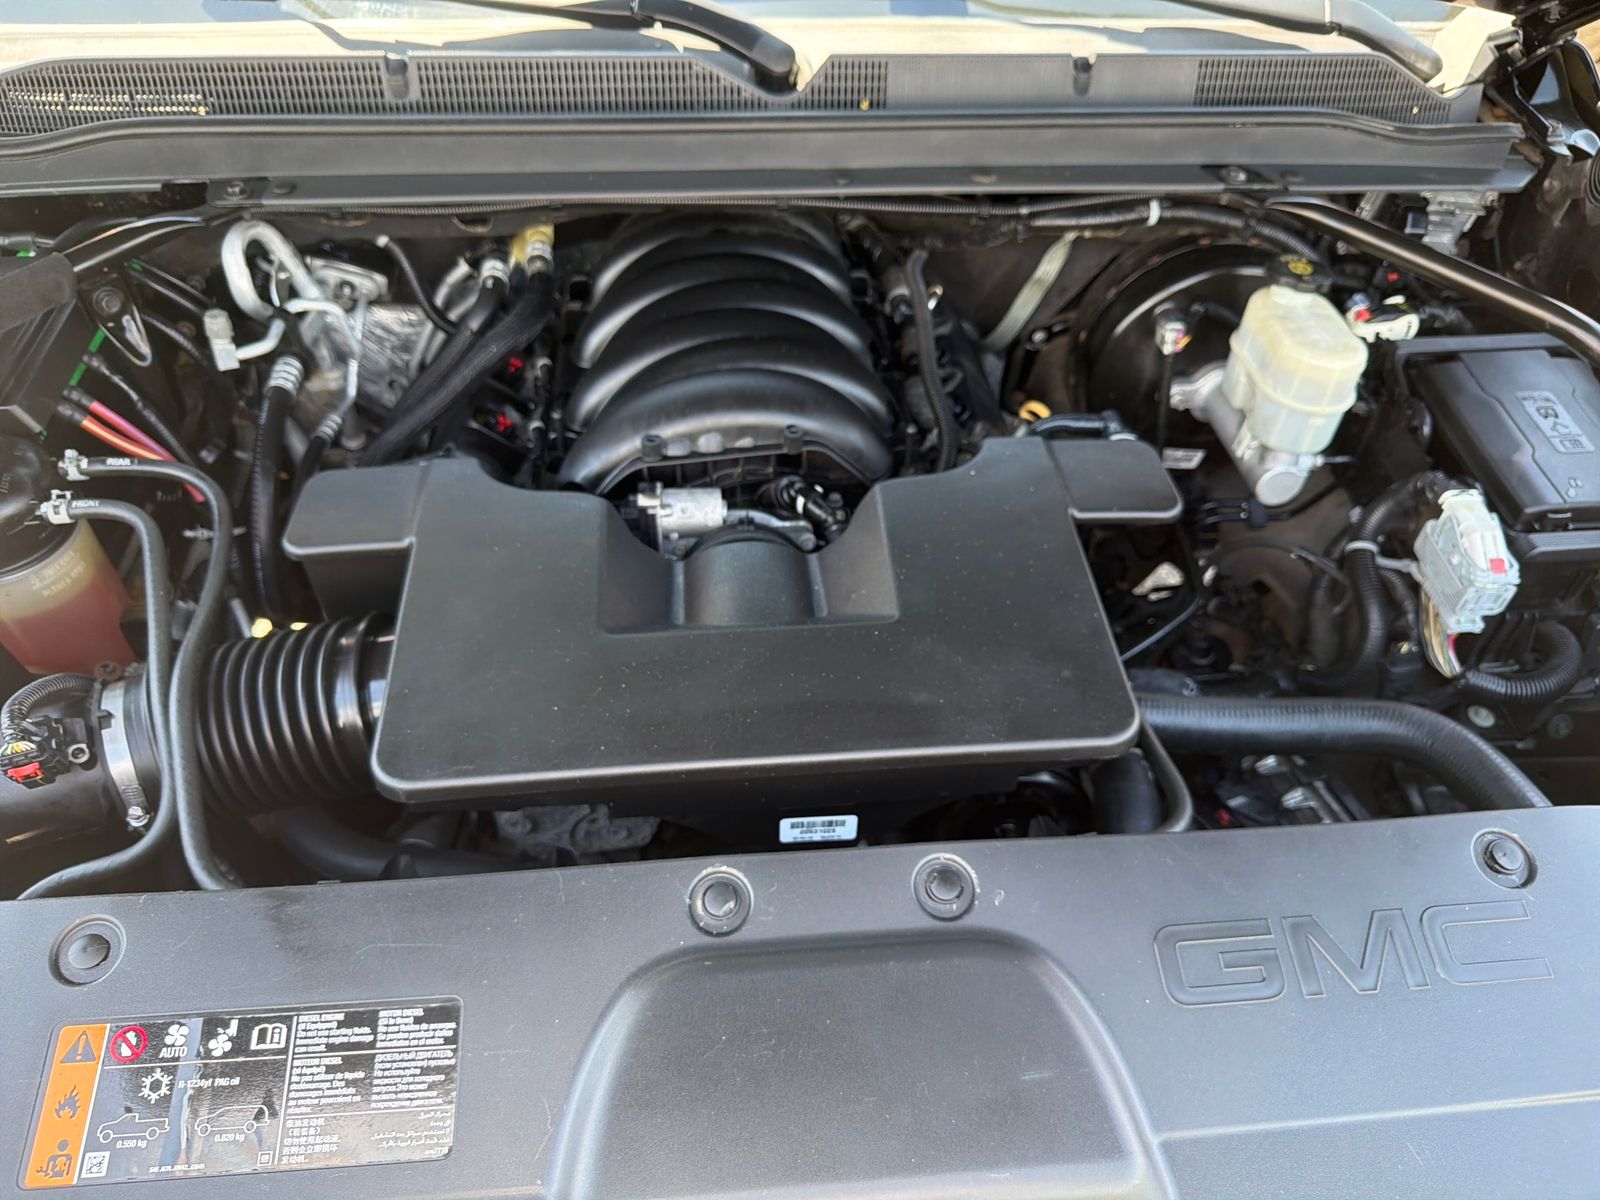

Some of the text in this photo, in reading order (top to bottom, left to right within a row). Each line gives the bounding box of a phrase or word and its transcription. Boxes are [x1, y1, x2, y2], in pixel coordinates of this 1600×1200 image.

[1153, 899, 1553, 1008] GMC
[159, 1046, 188, 1059] AUTO
[178, 1077, 240, 1089] R-1234yf PAG oil
[214, 1132, 245, 1142] 0.820 kg
[116, 1139, 147, 1149] 0.550 kg
